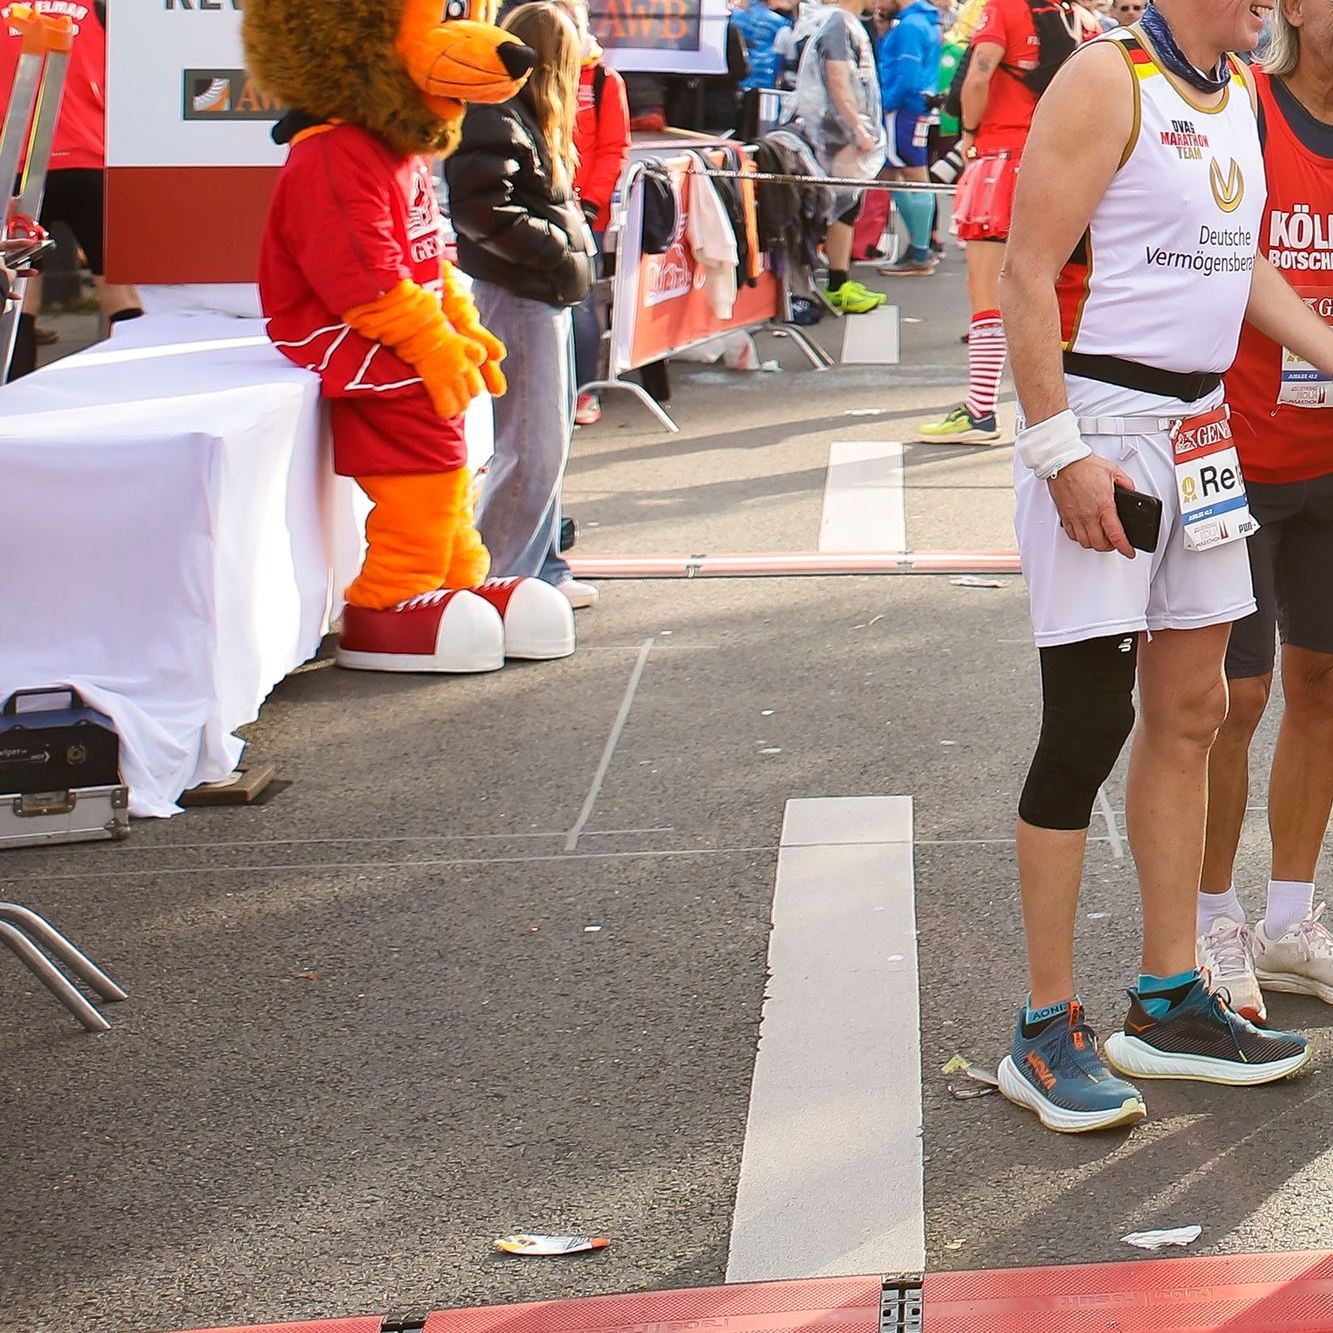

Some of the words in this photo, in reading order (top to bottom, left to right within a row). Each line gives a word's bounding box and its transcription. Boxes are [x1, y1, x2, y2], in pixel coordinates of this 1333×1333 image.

[1160, 131, 1210, 148] MARATHON
[1176, 146, 1203, 160] TEAM
[1199, 224, 1252, 247] Deutsche
[1145, 246, 1256, 277] Vermögensbera
